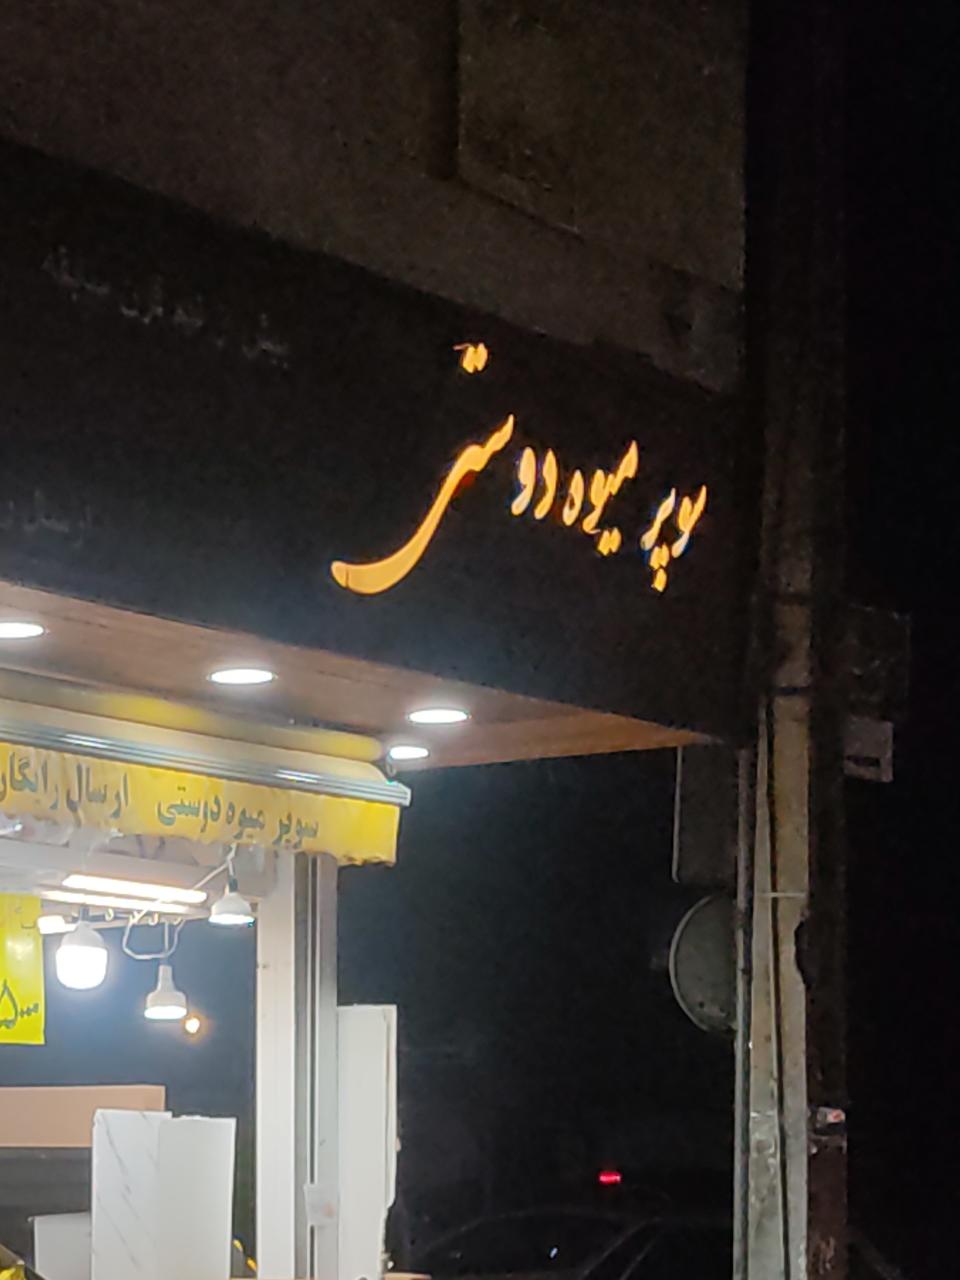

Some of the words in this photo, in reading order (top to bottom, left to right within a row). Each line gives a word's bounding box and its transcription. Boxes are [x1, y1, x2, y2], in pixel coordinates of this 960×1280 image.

[66, 761, 130, 820] ارسال
[157, 785, 222, 834] دوستی
[226, 801, 266, 840] میوه
[272, 811, 319, 849] سوپر
